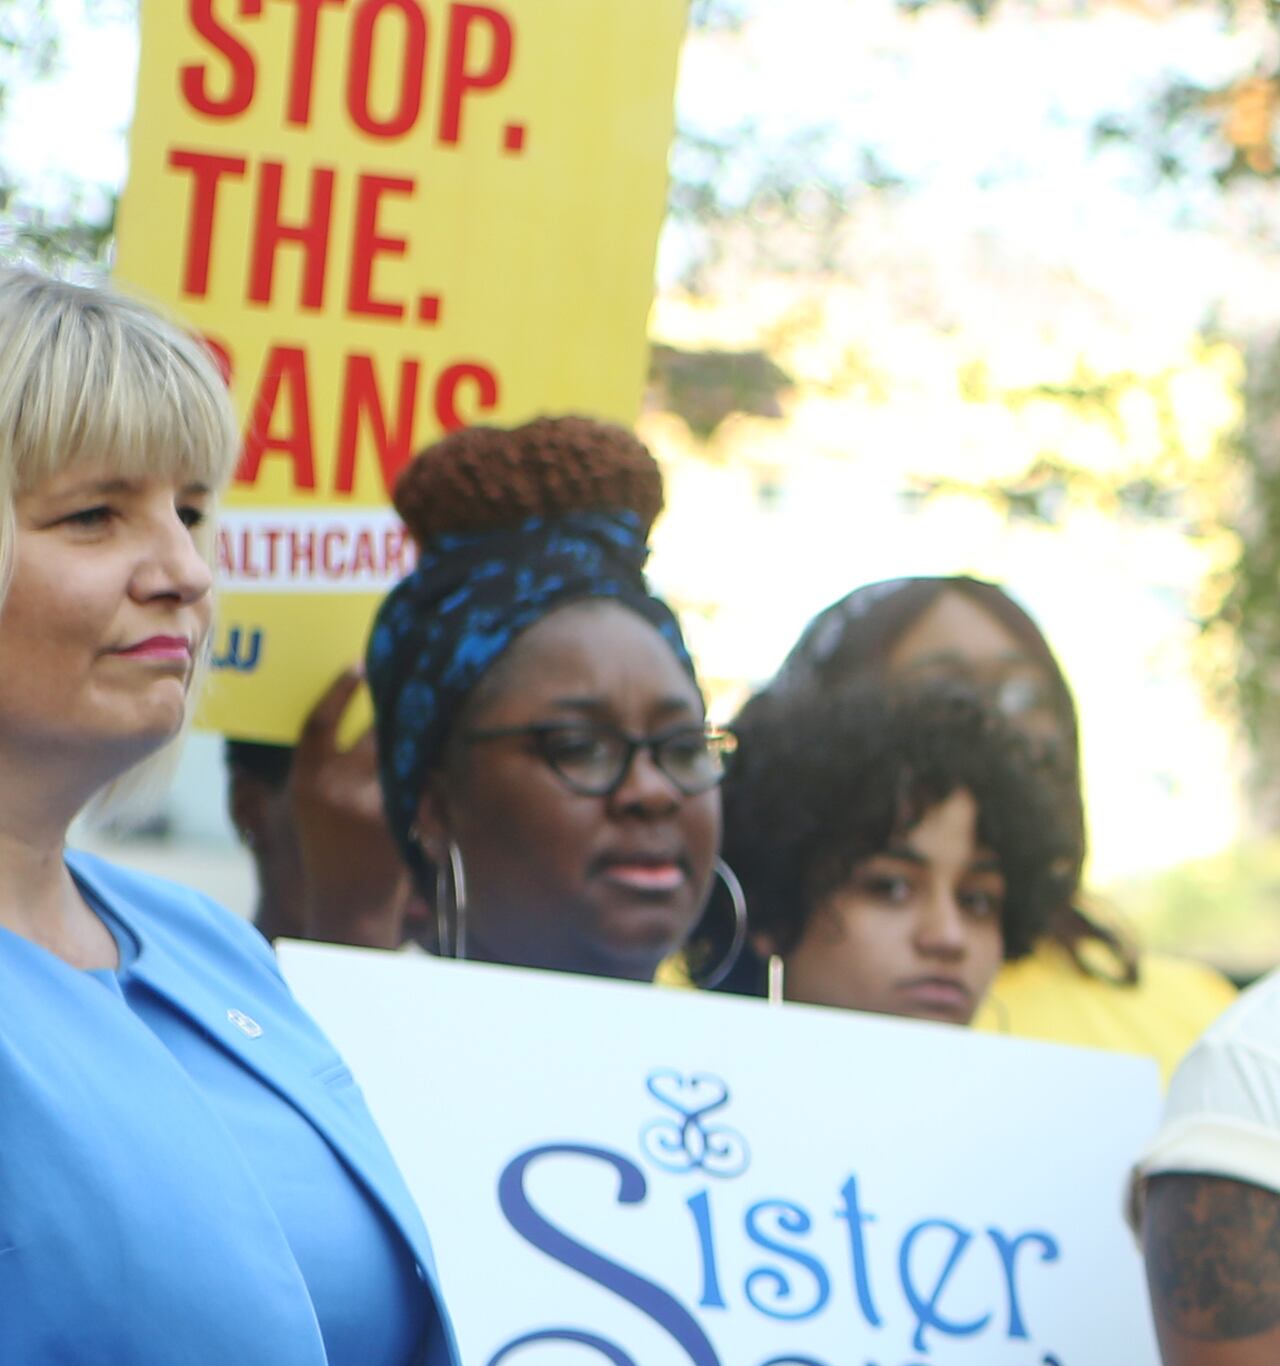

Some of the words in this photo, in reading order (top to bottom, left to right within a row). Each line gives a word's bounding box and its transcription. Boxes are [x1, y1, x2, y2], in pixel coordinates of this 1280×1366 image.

[178, 0, 528, 153] STOP.
[168, 149, 443, 324] THE.
[214, 525, 412, 580] ALTHCAR
